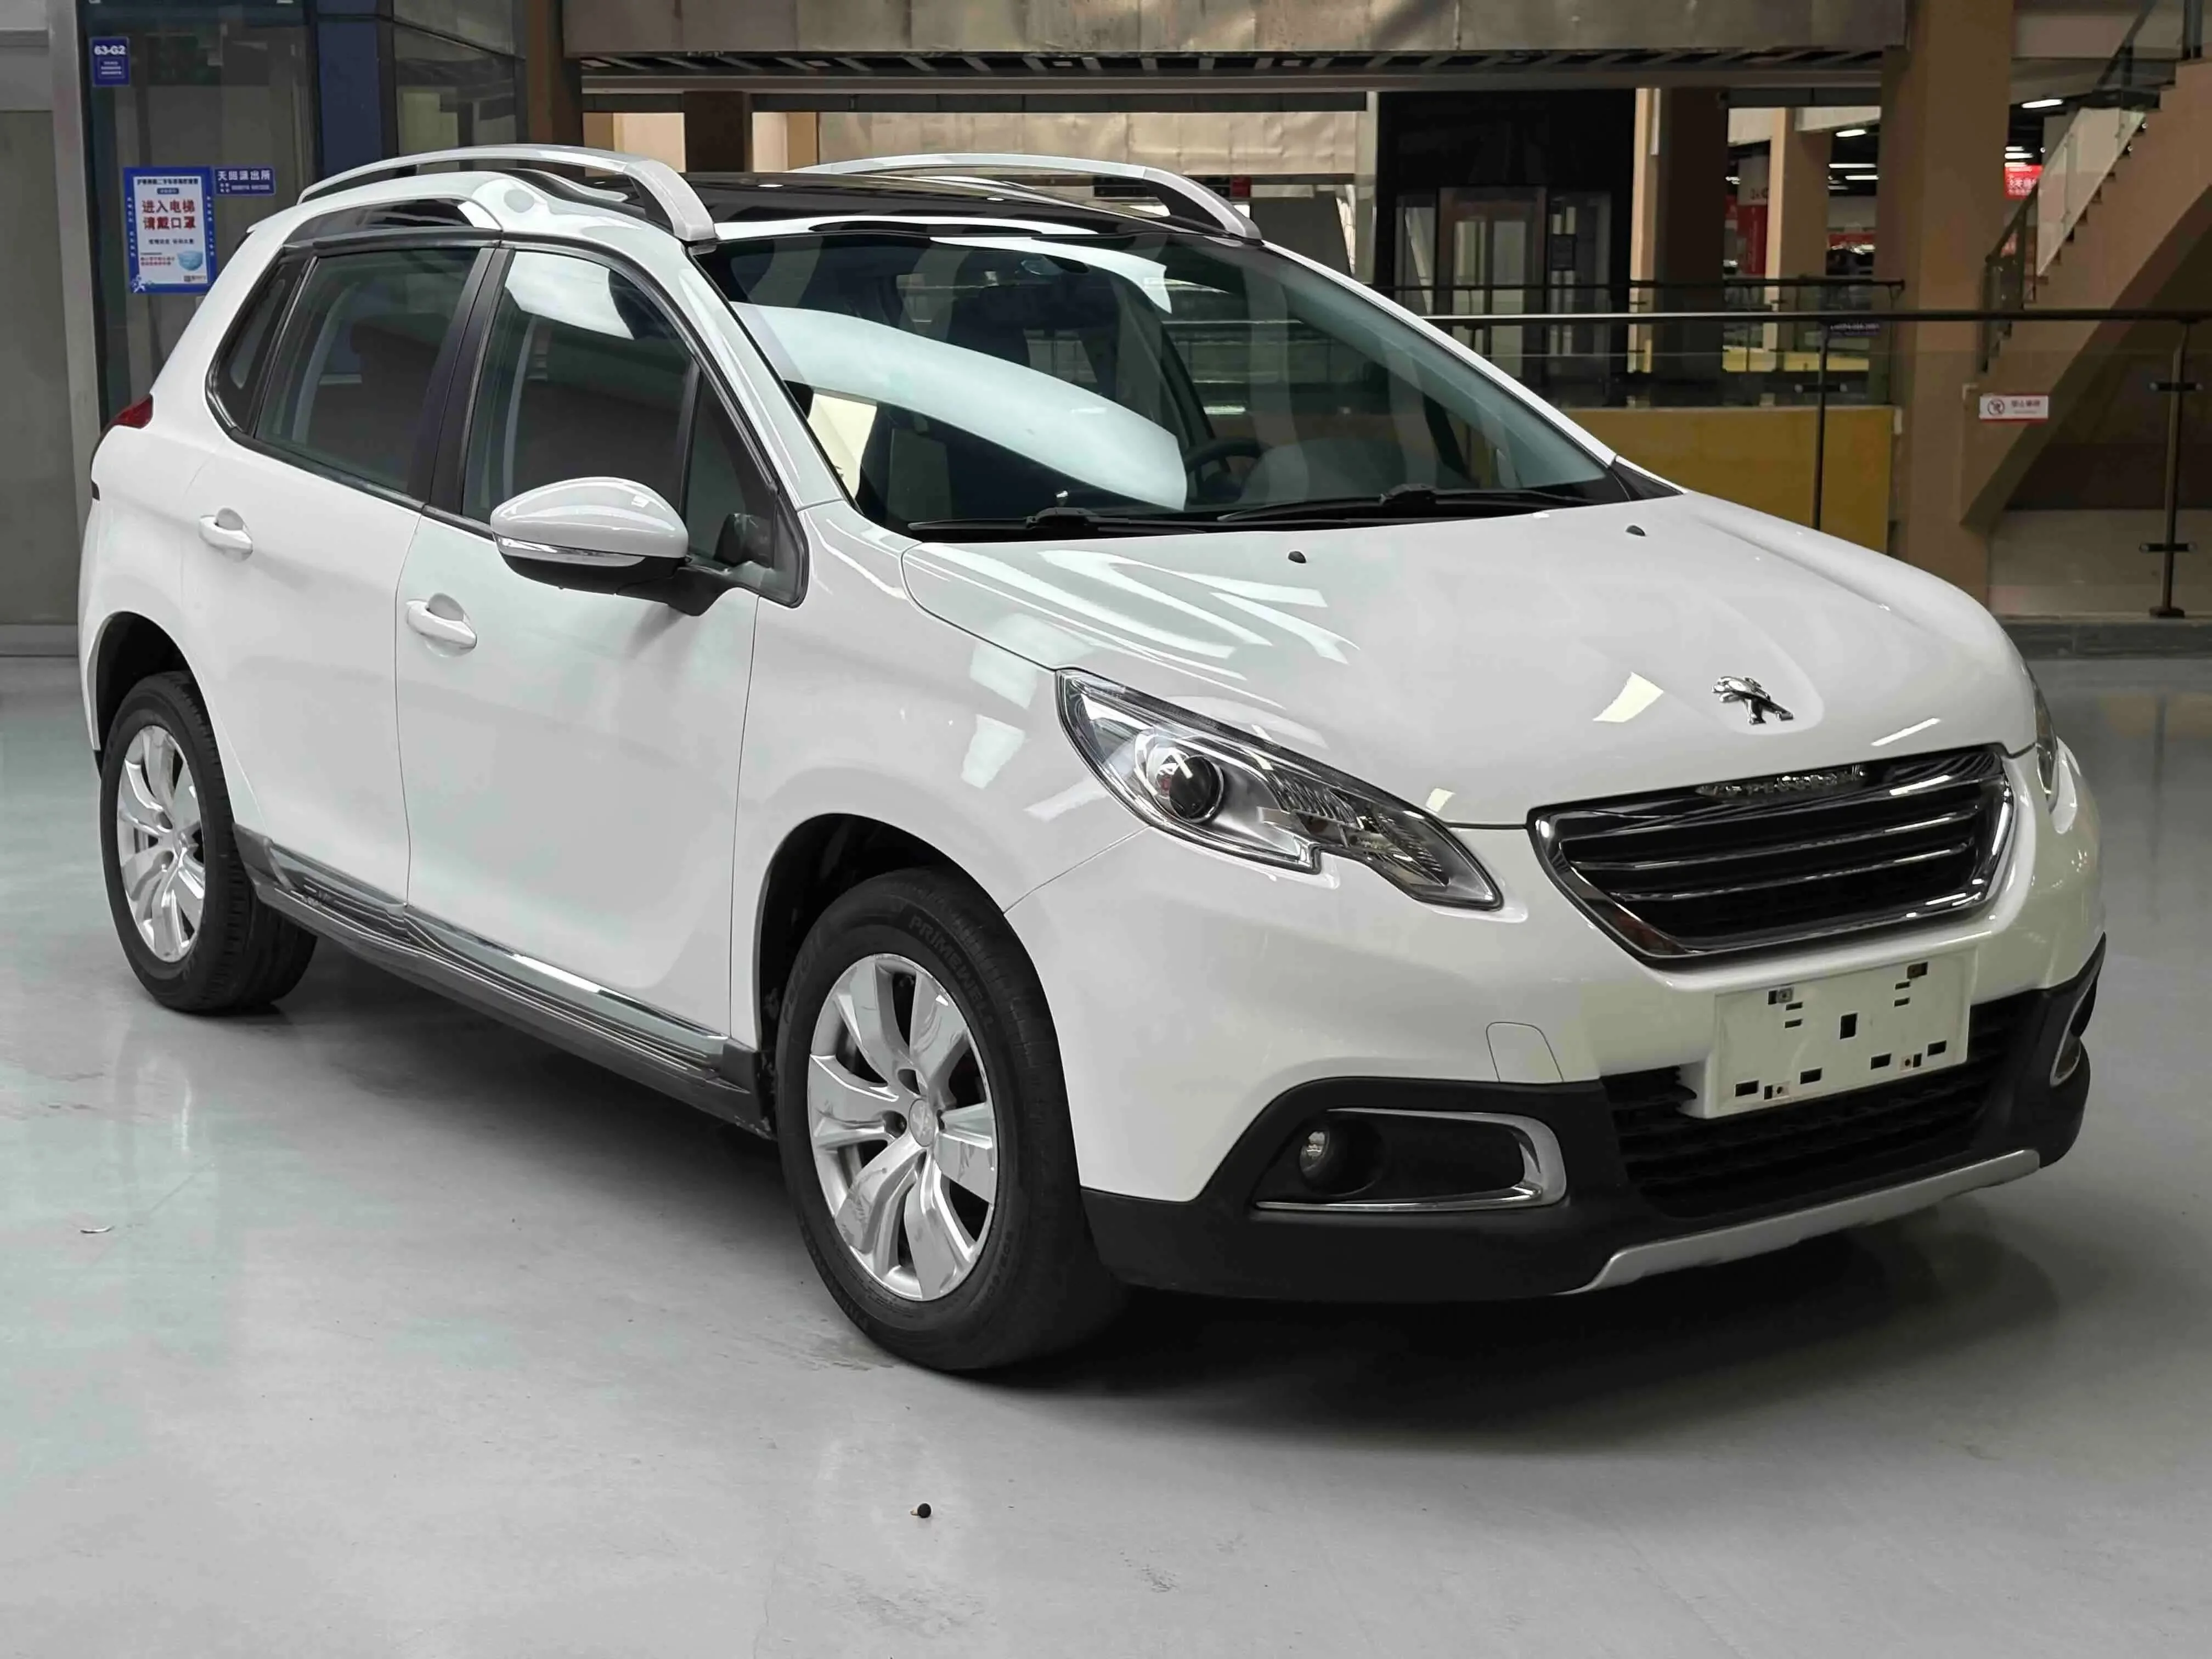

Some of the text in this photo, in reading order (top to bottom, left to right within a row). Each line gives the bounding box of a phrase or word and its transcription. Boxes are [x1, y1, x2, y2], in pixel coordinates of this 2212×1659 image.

[94, 44, 126, 55] 63-G2
[142, 199, 195, 213] 进入电梯
[143, 216, 196, 230] 请戴口罩
[909, 915, 994, 1032] PRIMEWELL
